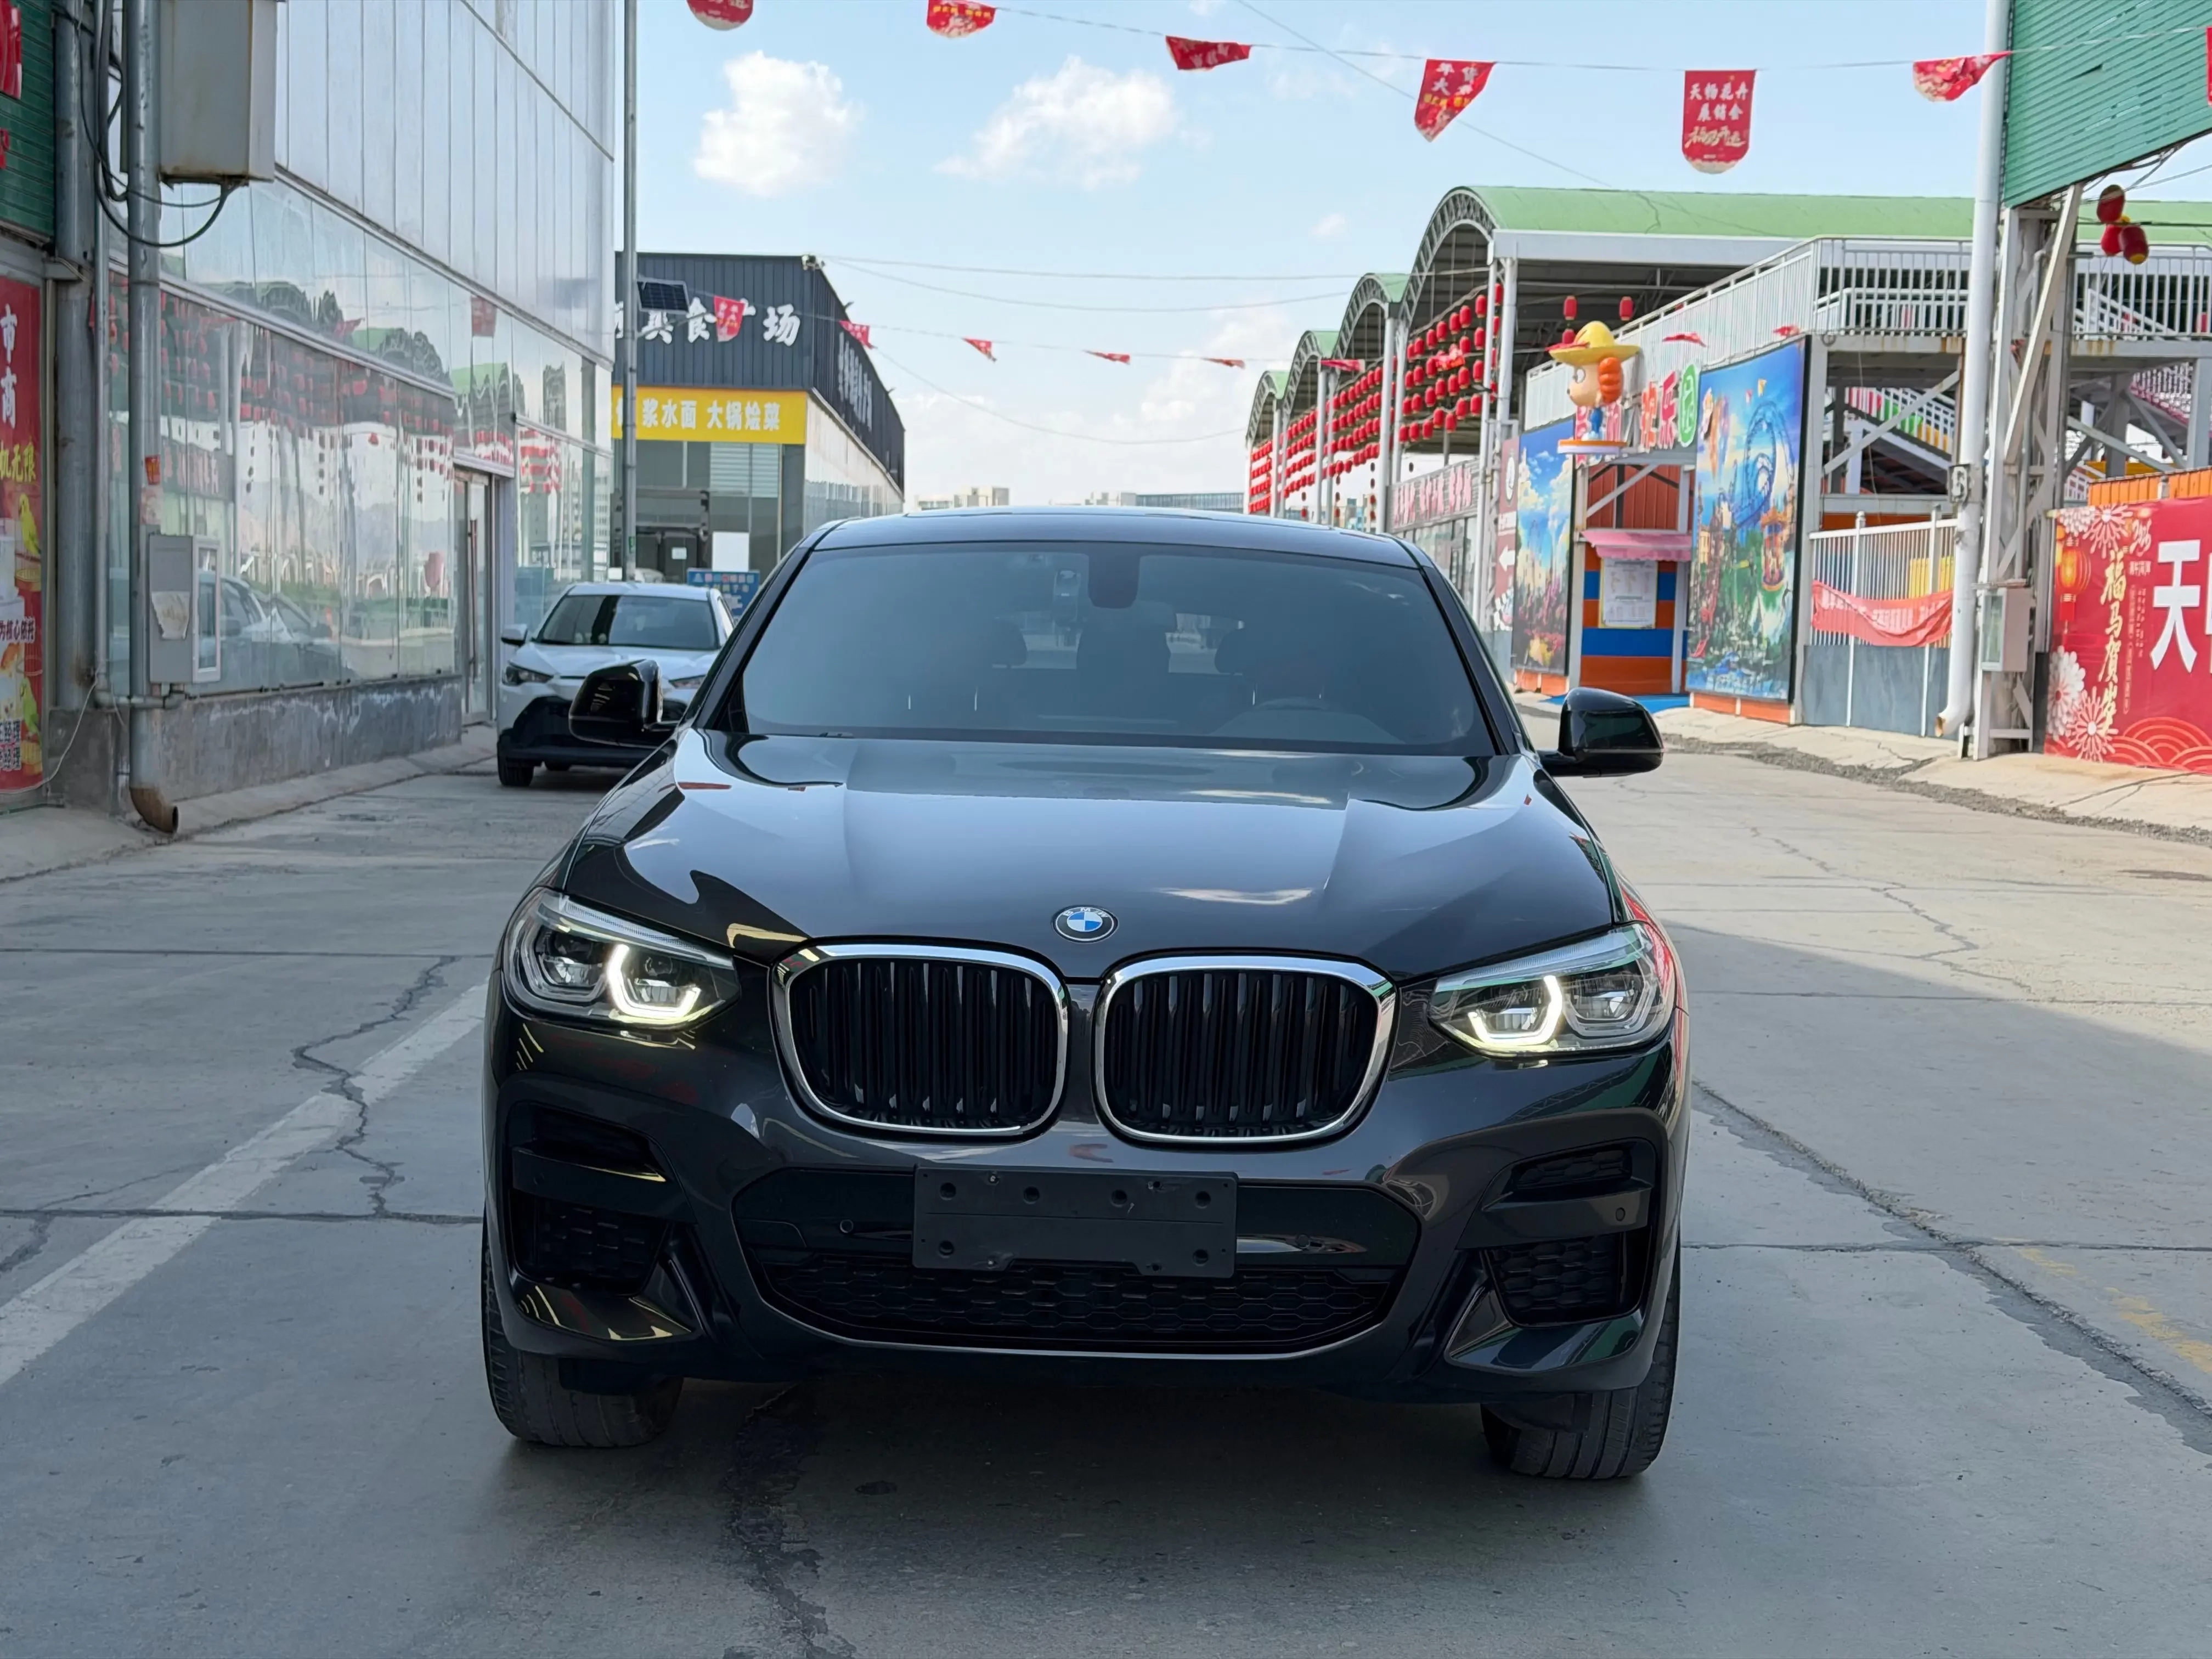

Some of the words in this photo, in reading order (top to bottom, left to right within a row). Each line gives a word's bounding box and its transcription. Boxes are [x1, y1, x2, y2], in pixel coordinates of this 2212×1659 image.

[642, 398, 697, 430] 浆水面
[2150, 539, 2212, 674] 天
[1062, 907, 1110, 917] BMW
